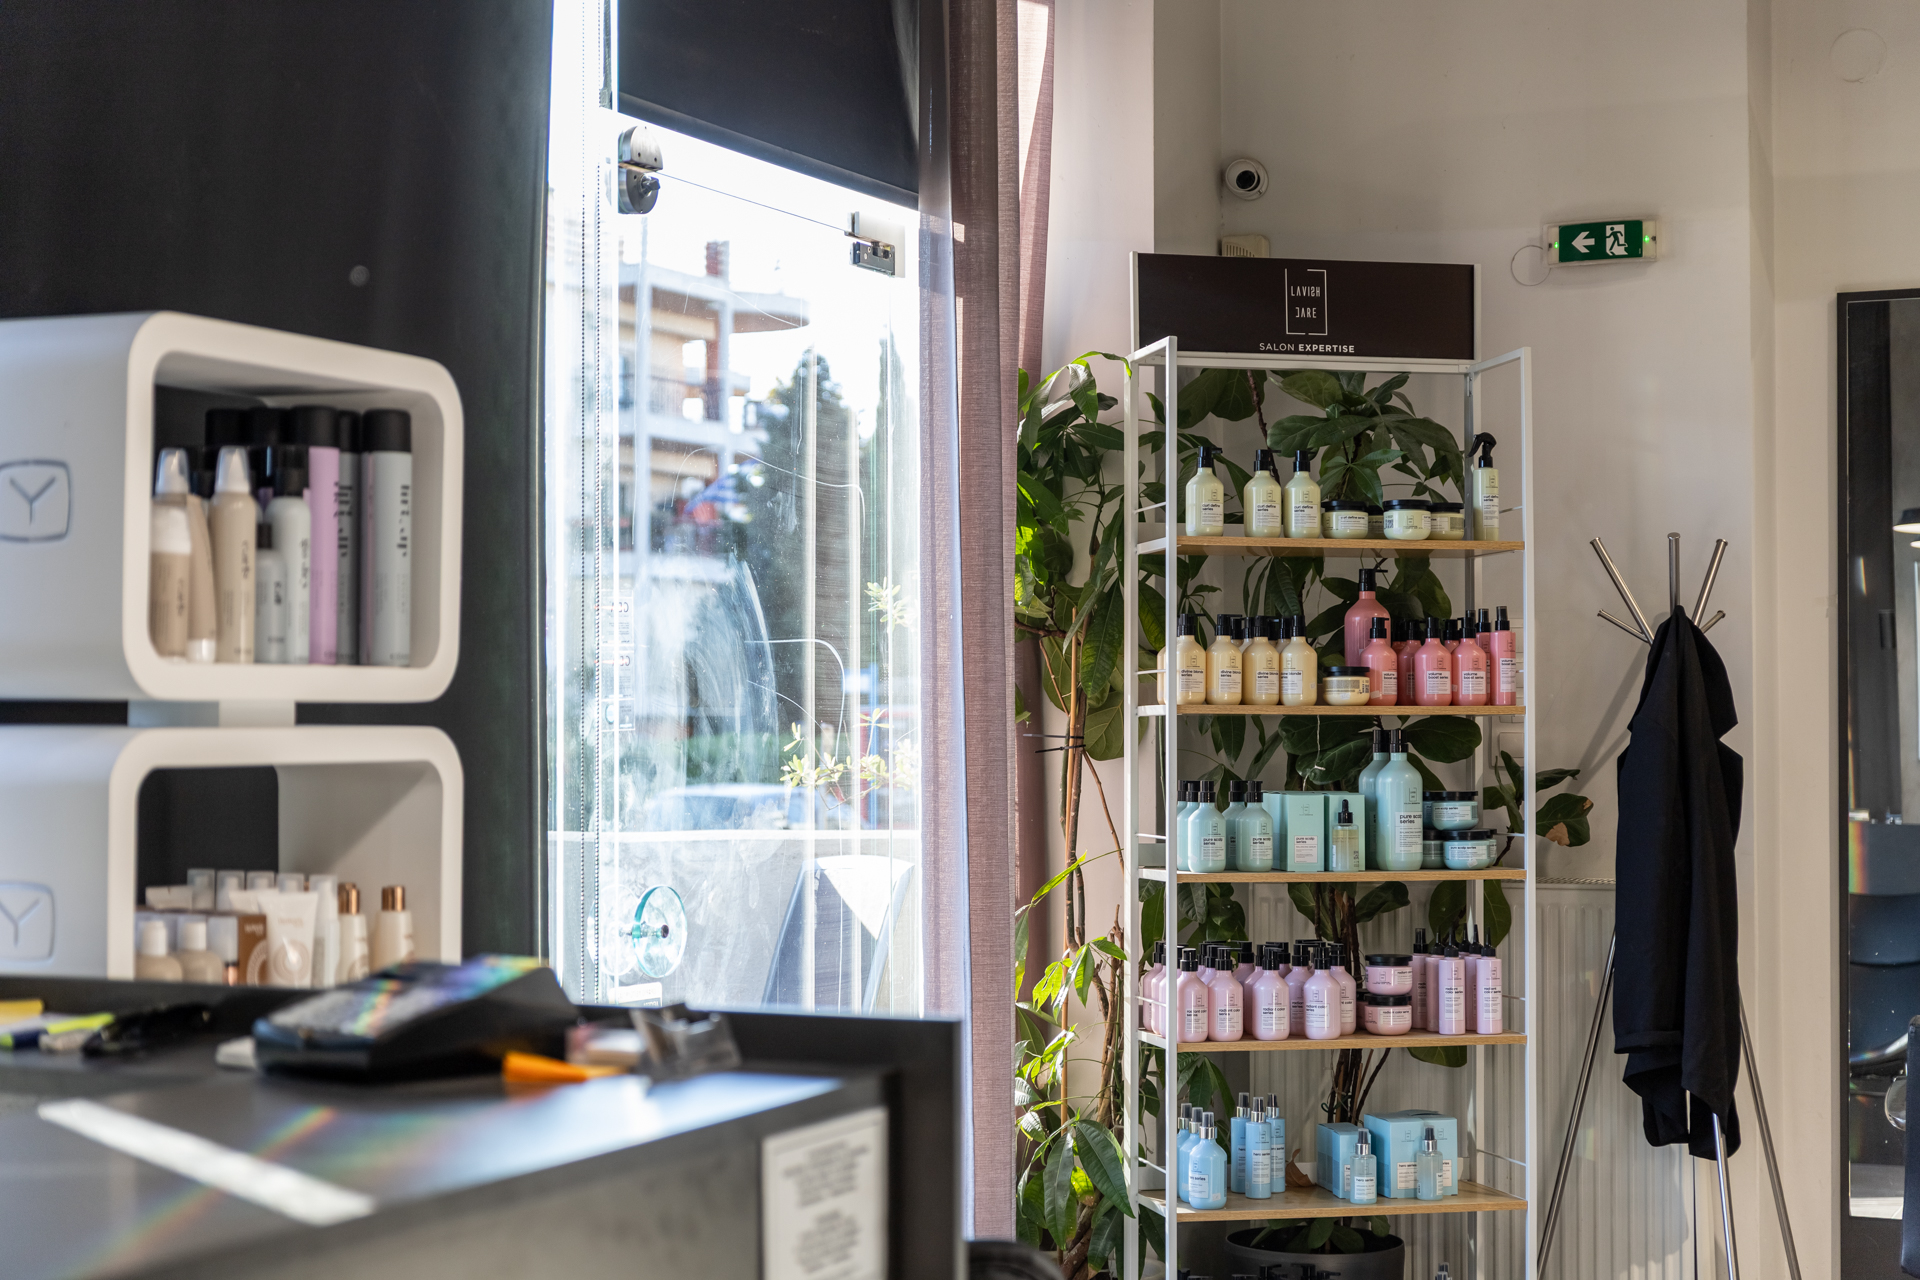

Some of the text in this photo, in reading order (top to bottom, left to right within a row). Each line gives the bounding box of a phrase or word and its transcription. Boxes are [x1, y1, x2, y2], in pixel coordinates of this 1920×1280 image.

[1290, 285, 1321, 297] LAVISH
[1295, 306, 1317, 319] CARE
[1259, 342, 1355, 353] SALON EXPERTISE
